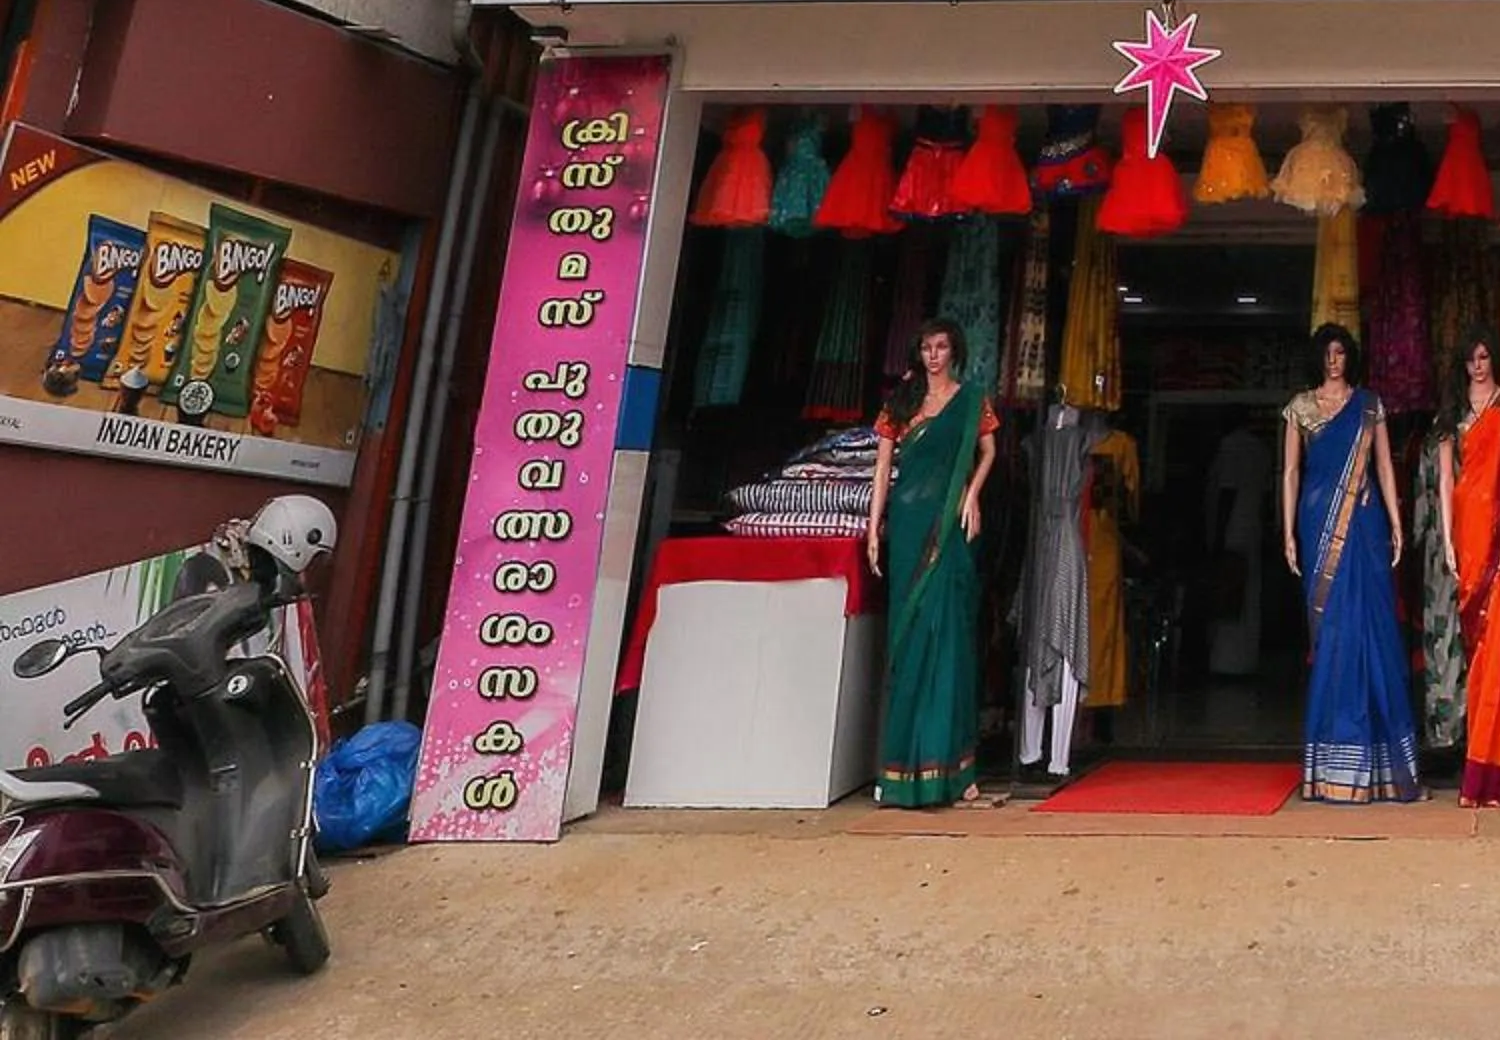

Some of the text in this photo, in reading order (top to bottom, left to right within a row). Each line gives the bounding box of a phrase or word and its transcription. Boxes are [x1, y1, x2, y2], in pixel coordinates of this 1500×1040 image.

[10, 150, 58, 191] NEW
[219, 241, 274, 282] BINGO!
[275, 282, 320, 316] BINGO!
[96, 417, 240, 463] INDIAN BAKERY
